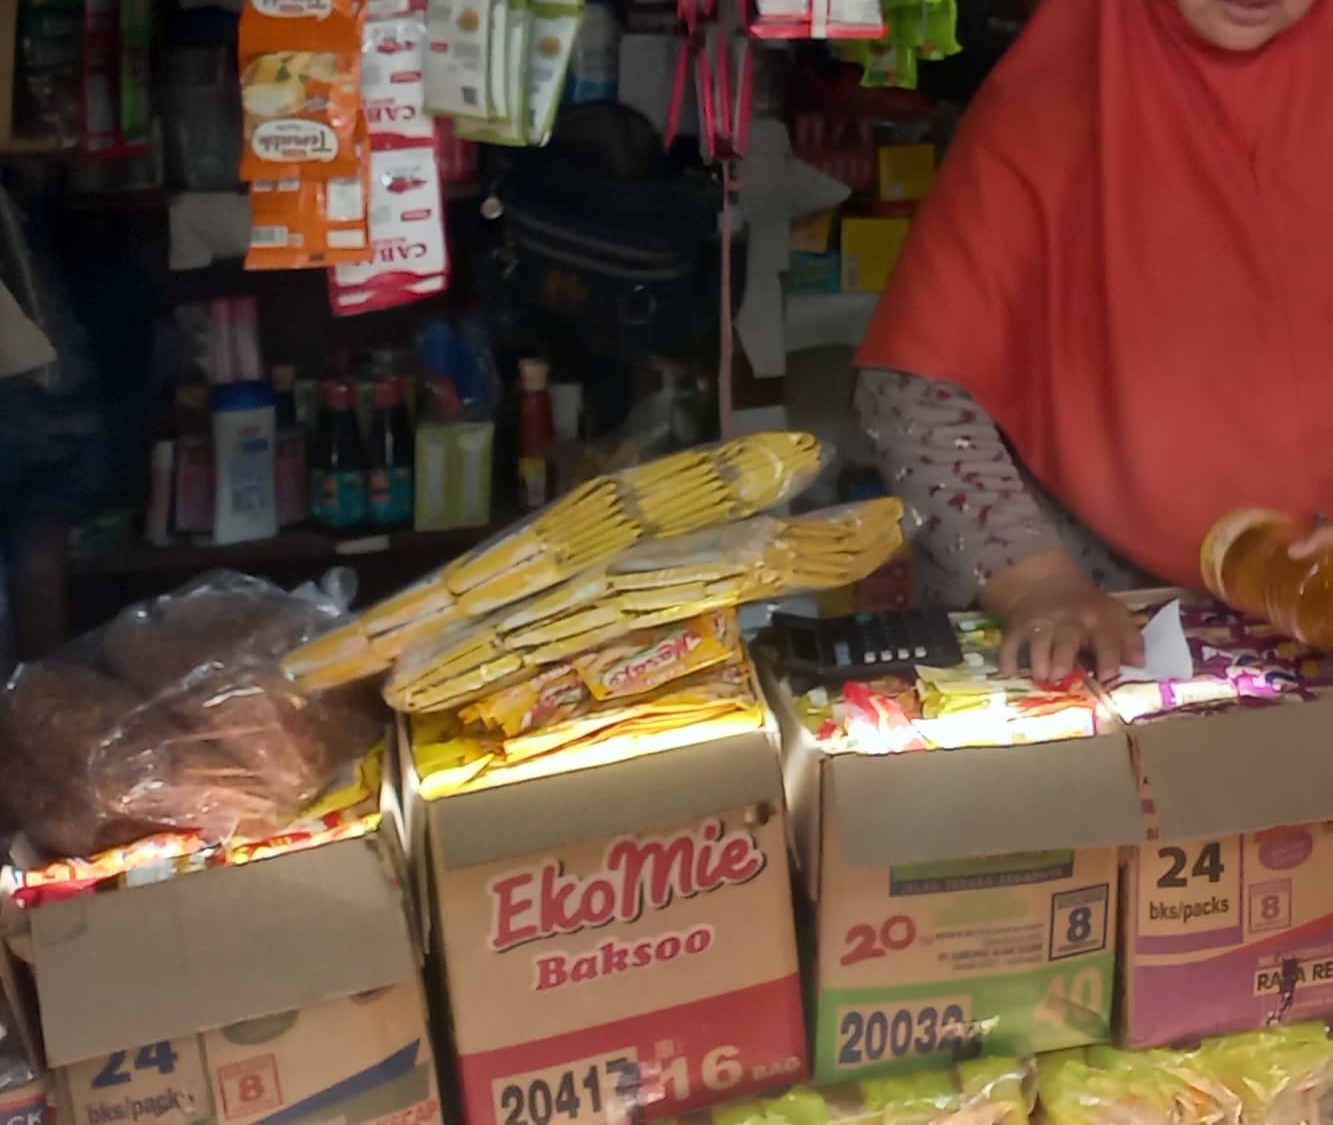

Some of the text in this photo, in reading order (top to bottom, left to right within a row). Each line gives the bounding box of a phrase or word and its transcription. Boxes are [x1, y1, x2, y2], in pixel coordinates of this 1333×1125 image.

[490, 816, 765, 952] EkoMie
[1155, 842, 1225, 889] 24
[1066, 906, 1092, 943] 8
[1149, 896, 1230, 923] bks/packs
[1261, 895, 1281, 920] 8
[534, 924, 713, 992] Baksoo
[840, 914, 917, 967] 20
[1033, 966, 1104, 1027] 40
[1256, 966, 1306, 992] RAA
[91, 1040, 179, 1090] 24
[238, 1074, 265, 1103] 8
[661, 1044, 744, 1100] 16
